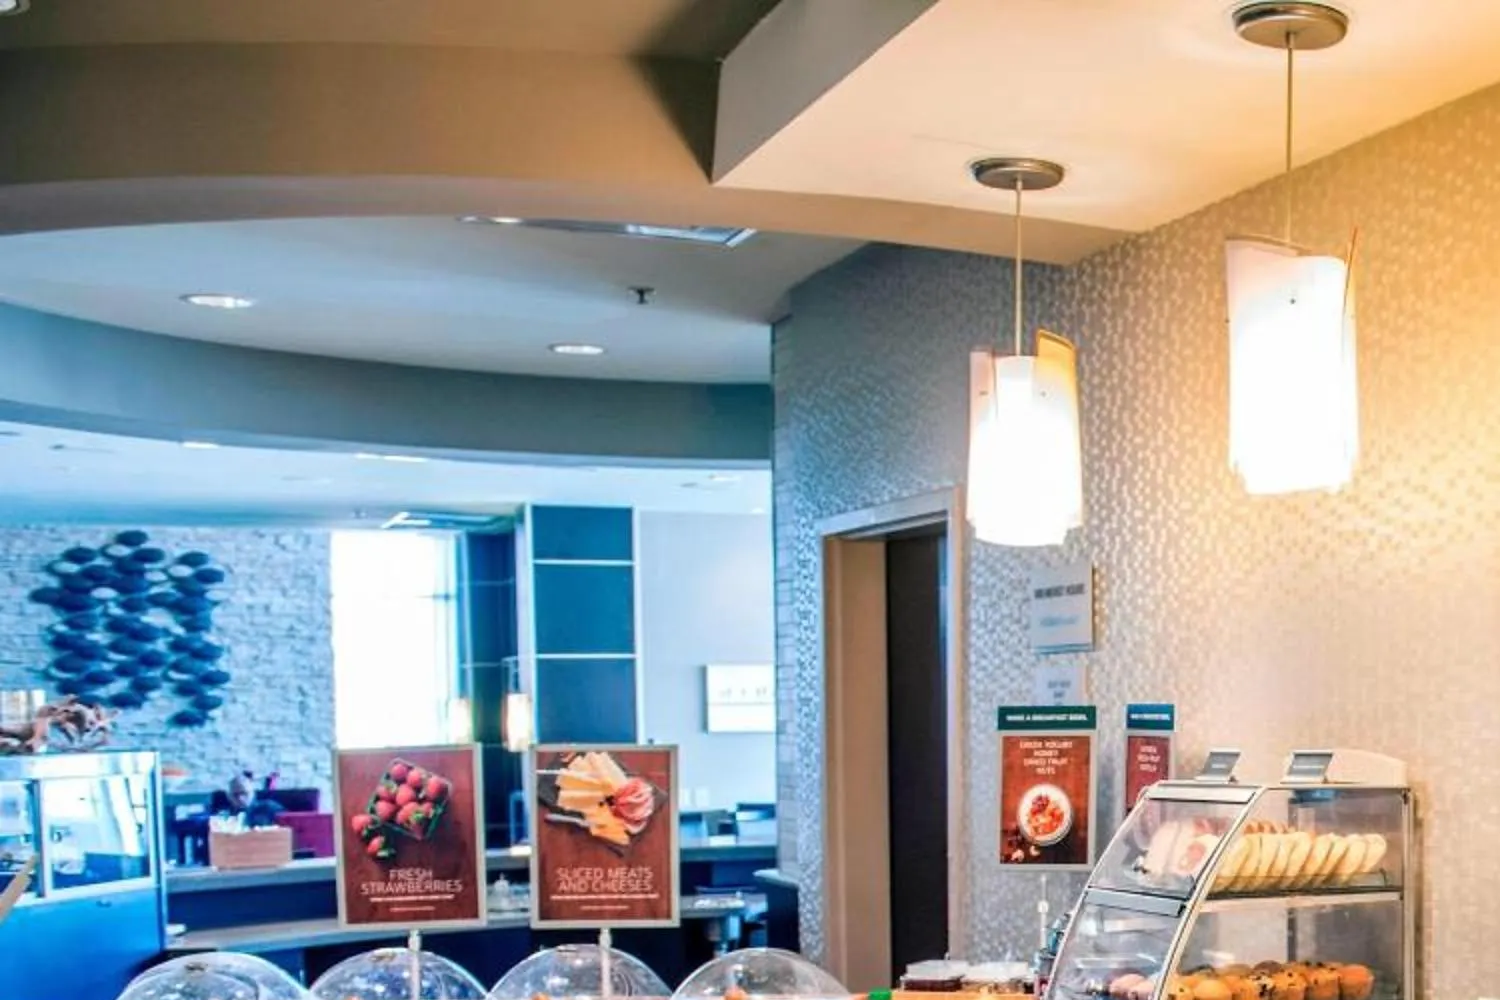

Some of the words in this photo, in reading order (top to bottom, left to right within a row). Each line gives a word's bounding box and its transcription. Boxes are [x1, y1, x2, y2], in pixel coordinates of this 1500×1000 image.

[389, 868, 433, 881] FRESH
[556, 867, 604, 880] SLICED
[607, 866, 654, 880] MEATS
[360, 880, 463, 895] STRAWBERRIES
[558, 880, 589, 893] AND
[592, 880, 654, 892] CHEESES
